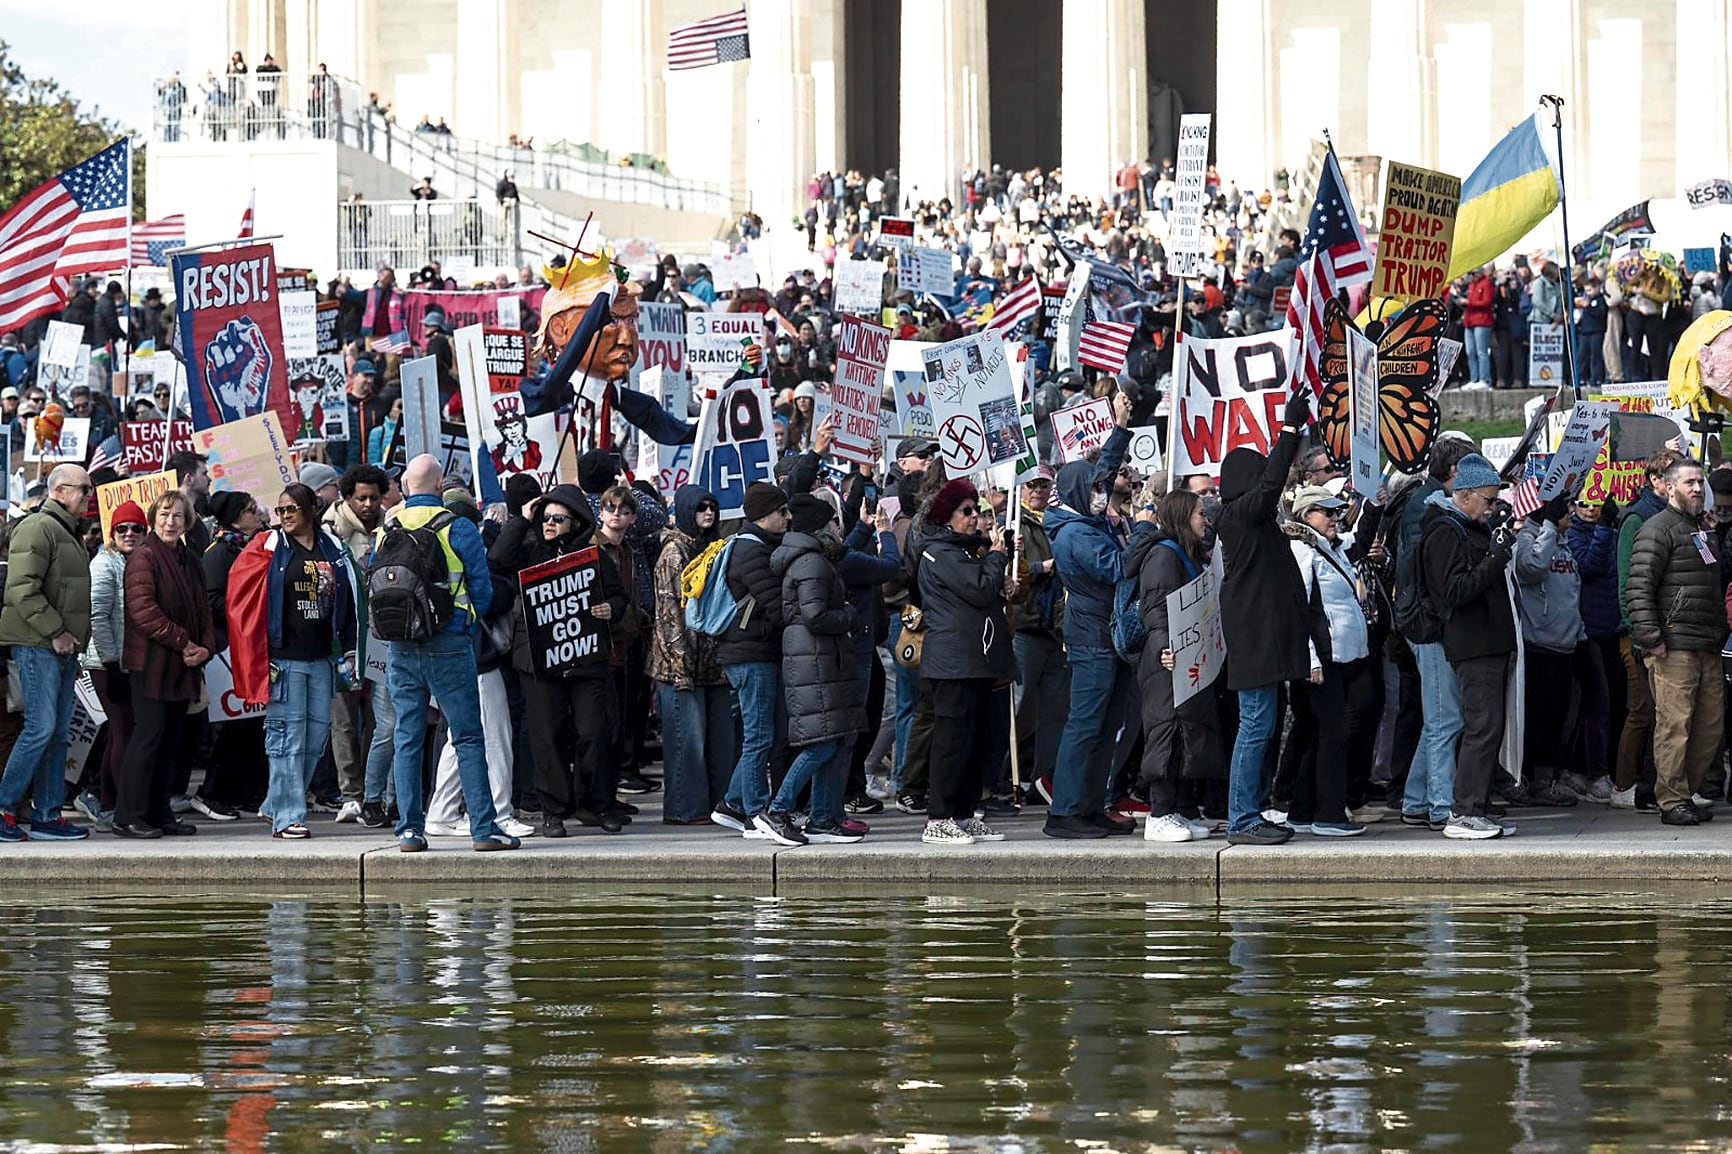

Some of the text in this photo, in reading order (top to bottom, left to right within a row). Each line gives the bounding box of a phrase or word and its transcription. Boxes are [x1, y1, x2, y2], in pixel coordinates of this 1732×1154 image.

[1391, 167, 1424, 190] MAKE
[1388, 187, 1458, 218] PROUD AGAIN
[1385, 208, 1443, 237] DUMP
[1382, 233, 1447, 264] TRAITOR
[183, 256, 270, 312] RESIST!
[1382, 260, 1444, 298] TRUMP
[317, 309, 338, 320] UMP
[317, 320, 336, 330] UST
[650, 307, 682, 335] WANT
[694, 316, 760, 335] 3 EQUAL
[511, 335, 524, 347] SE
[840, 321, 890, 364] NO KINGS
[488, 360, 523, 374] TRUMP
[640, 338, 682, 374] YOU
[688, 349, 743, 363] BRANCH
[1185, 341, 1288, 397] NO
[1380, 362, 1418, 375] CHILDREN
[845, 361, 877, 387] ANYTIME
[833, 383, 866, 413] VIOLATORS
[911, 410, 932, 426] PEDO
[1072, 408, 1097, 425] NO
[1080, 437, 1102, 450] ANY
[104, 477, 170, 511] DUMP TRUMP
[526, 567, 596, 607] TRUMP
[535, 590, 591, 627] MUST
[552, 616, 582, 642] GO
[545, 632, 599, 669] NOW!
